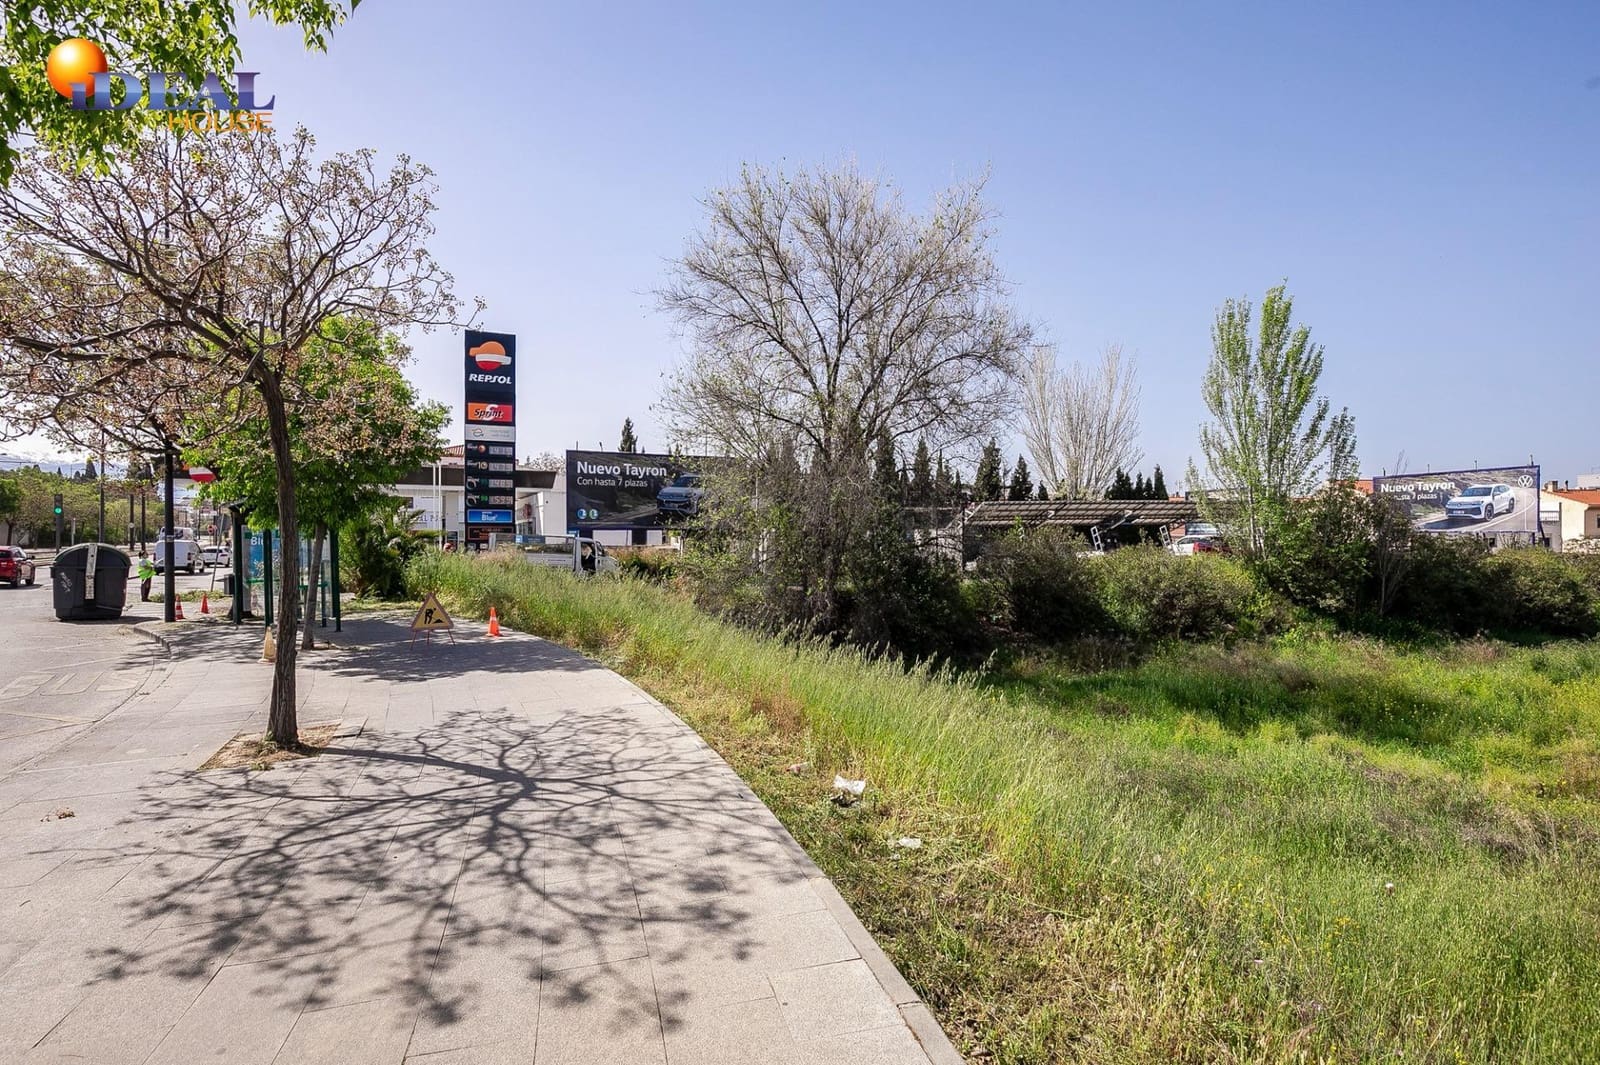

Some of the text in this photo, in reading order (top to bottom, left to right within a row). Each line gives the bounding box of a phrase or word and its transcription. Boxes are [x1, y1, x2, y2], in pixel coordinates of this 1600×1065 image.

[469, 373, 512, 385] REPSOL
[577, 461, 667, 479] Nuevo Tayron
[577, 477, 648, 489] Con hasta 7 plazas
[1381, 481, 1456, 493] Nuevo Tayron
[1417, 493, 1438, 501] plazas
